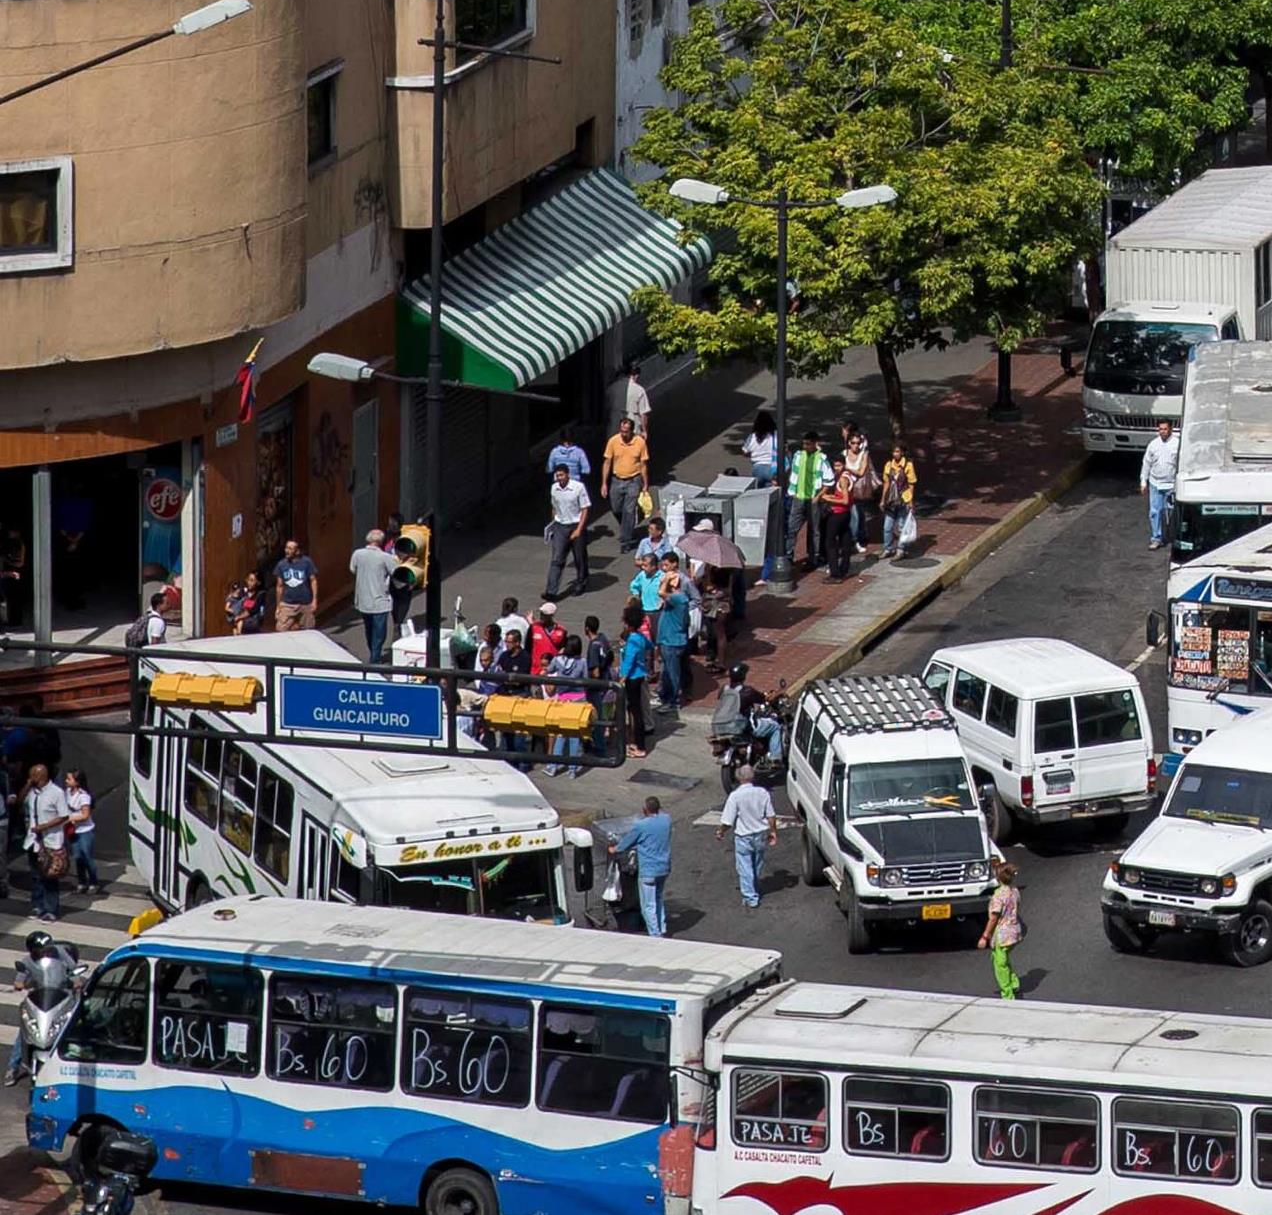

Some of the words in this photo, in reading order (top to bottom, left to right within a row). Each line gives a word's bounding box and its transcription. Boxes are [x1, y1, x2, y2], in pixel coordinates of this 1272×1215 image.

[1131, 384, 1166, 394] JAC
[150, 485, 179, 513] efe
[338, 689, 384, 705] CALLE
[313, 707, 410, 727] GUAICAIPURO
[400, 846, 428, 862] En
[434, 842, 483, 858] honor
[488, 839, 501, 850] a
[506, 835, 522, 848] ti
[320, 1033, 369, 1081] 60
[411, 1028, 451, 1088] Bs.
[457, 1030, 510, 1094] 60
[741, 1122, 813, 1144] PASAJE
[856, 1111, 885, 1145] Bs.
[988, 1119, 1028, 1159] 60
[769, 1153, 798, 1165] CHACAITO
[1187, 1135, 1224, 1180] 60
